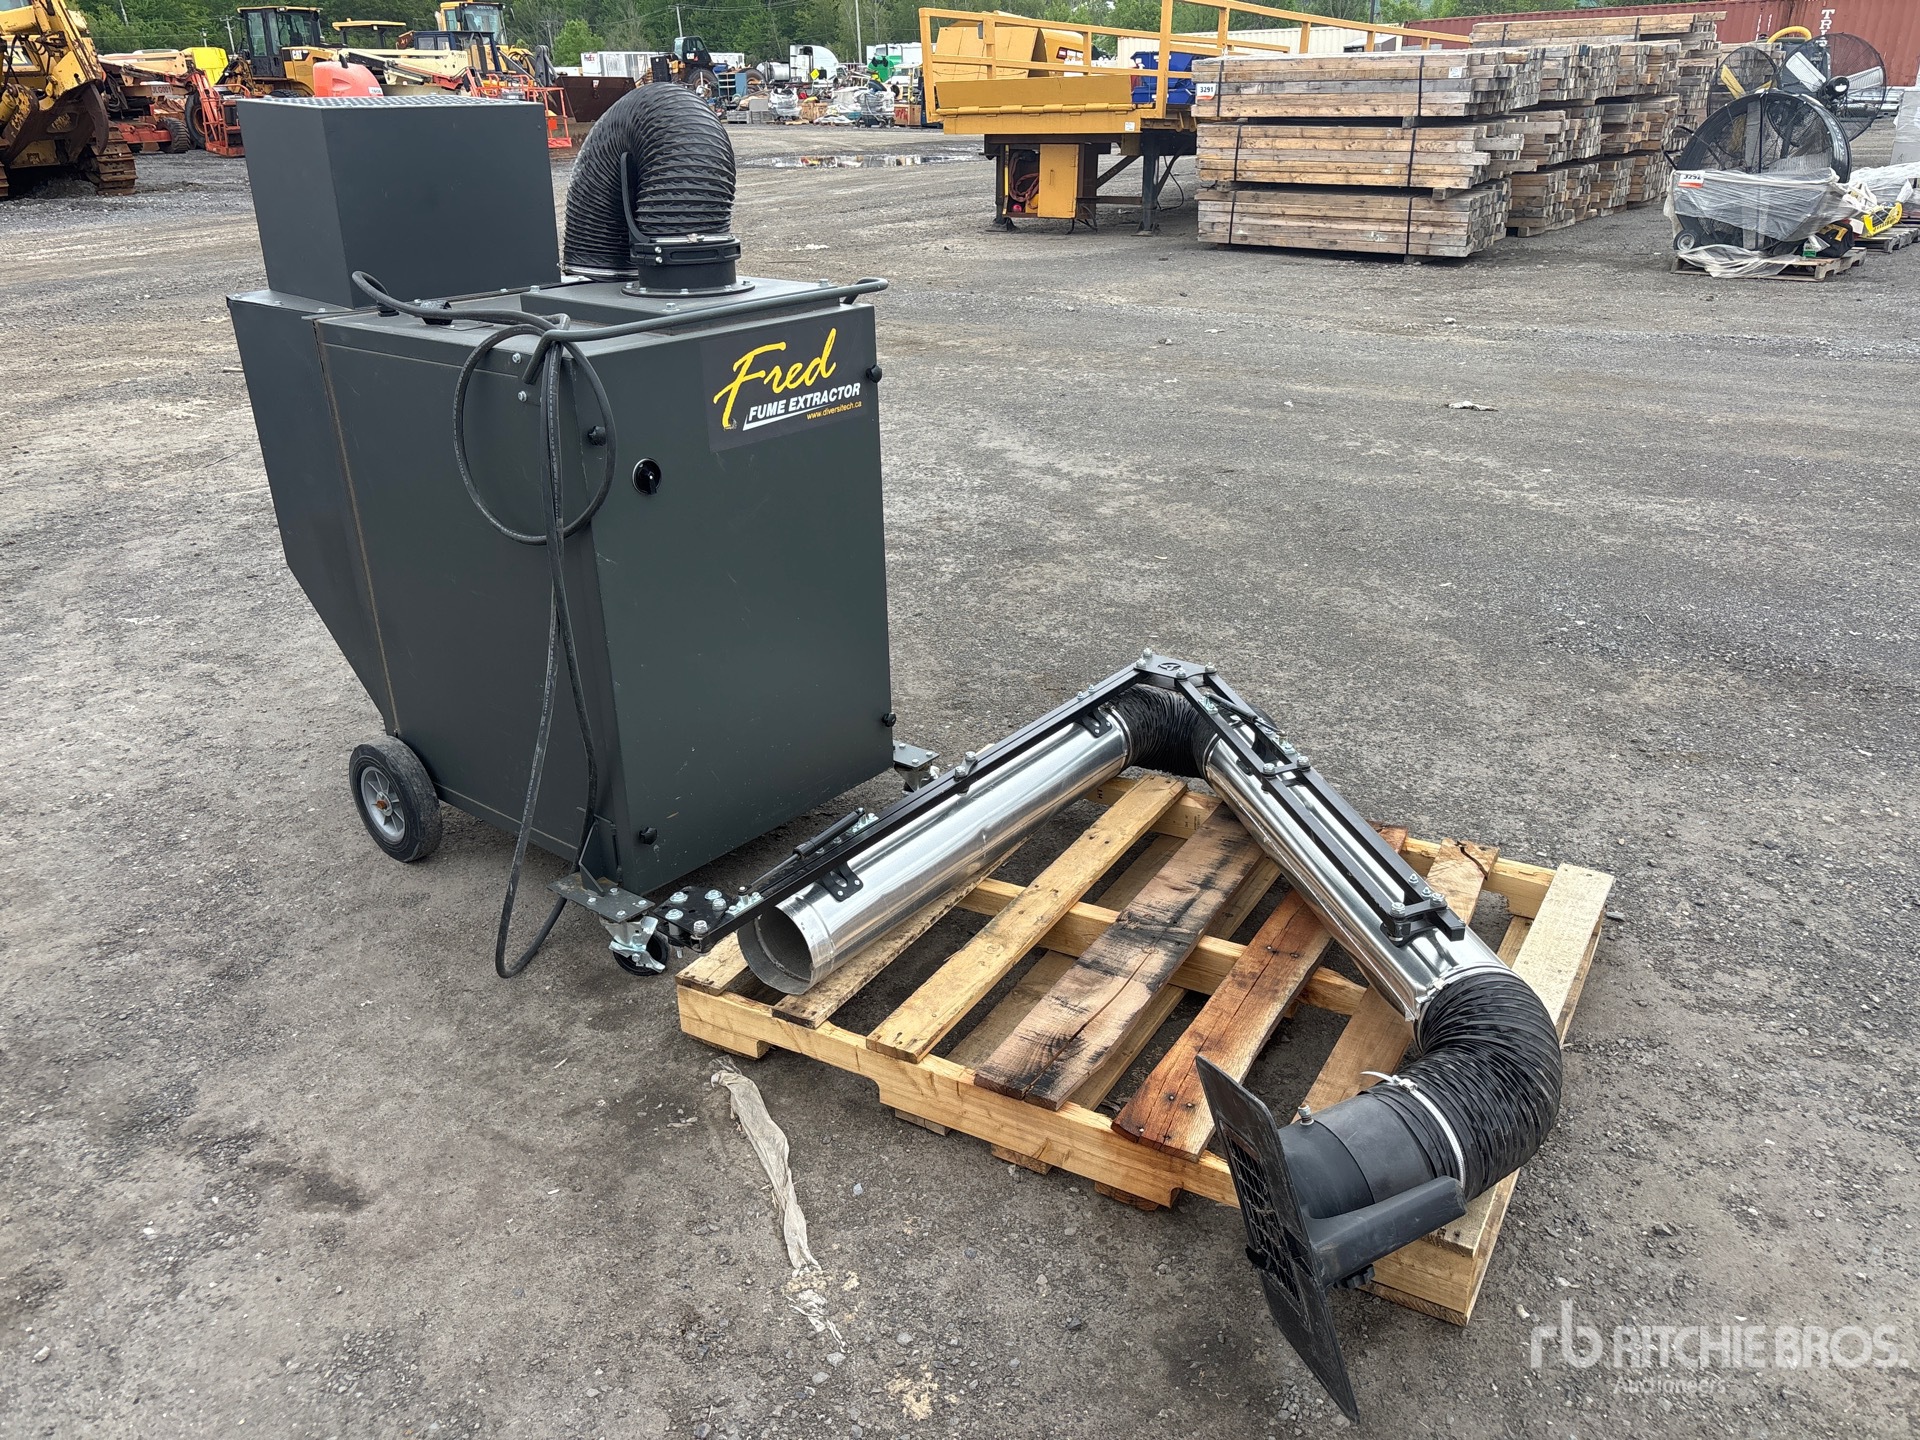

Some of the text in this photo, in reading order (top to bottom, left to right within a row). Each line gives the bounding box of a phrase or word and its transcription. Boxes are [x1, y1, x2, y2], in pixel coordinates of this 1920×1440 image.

[292, 50, 302, 60] CAT
[713, 327, 837, 431] Fred
[748, 382, 861, 422] FUME EXTRACTOR
[806, 401, 862, 421] www.diversitech.ca
